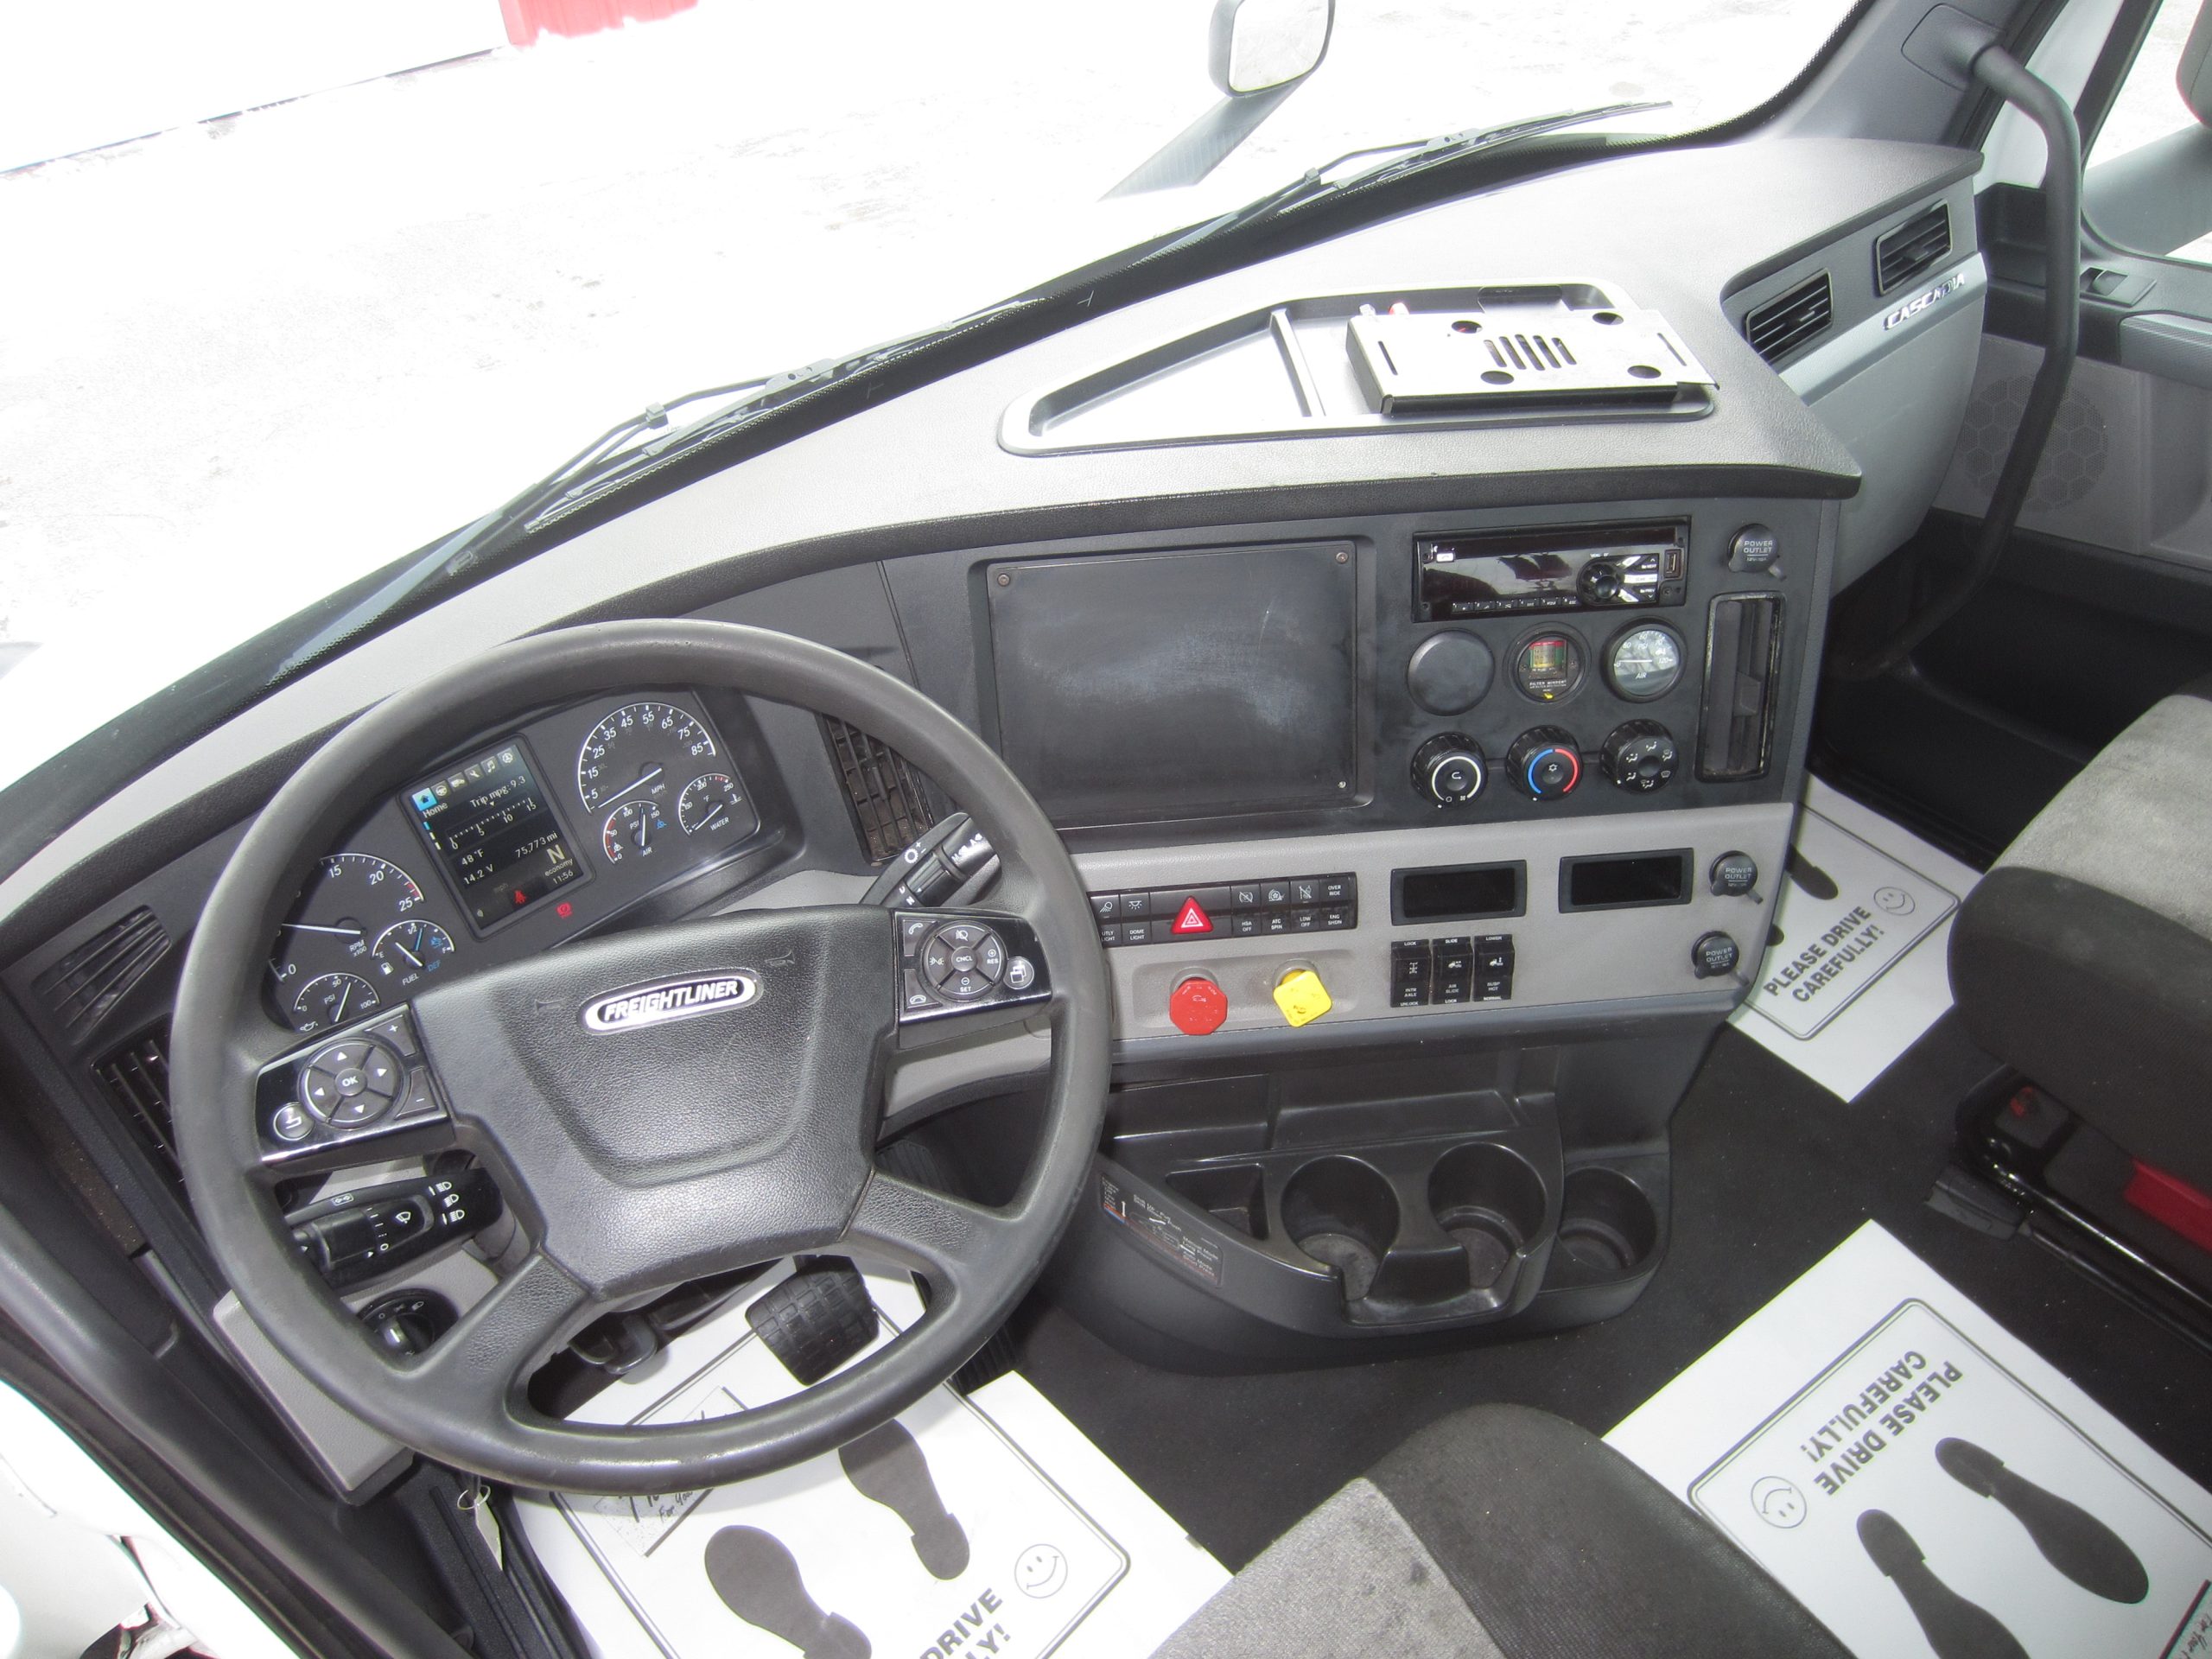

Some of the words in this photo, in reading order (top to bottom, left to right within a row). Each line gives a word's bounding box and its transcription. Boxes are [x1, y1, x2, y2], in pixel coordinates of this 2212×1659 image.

[1884, 272, 1965, 330] CASCADIA
[620, 715, 633, 728] 45
[643, 713, 655, 725] 55
[661, 717, 674, 729] 65
[604, 728, 617, 741] 35
[677, 728, 690, 740] 75
[593, 747, 605, 759] 25
[691, 744, 703, 755] 85
[588, 768, 599, 779] 15
[470, 795, 489, 808] Trip
[489, 785, 512, 801] mpg:
[510, 775, 526, 788] 9.3
[651, 784, 665, 794] MPH
[723, 782, 734, 791] 250
[592, 791, 599, 799] 5
[422, 802, 448, 819] Home
[526, 803, 537, 812] 15
[623, 809, 632, 818] 100
[503, 814, 513, 823] 10
[651, 810, 660, 819] 150
[629, 821, 639, 830] PSI
[710, 817, 730, 831] WATER
[546, 830, 558, 843] mi
[546, 844, 565, 864] N
[642, 847, 653, 857] AIR
[329, 865, 342, 878] 15
[544, 859, 573, 876] economy
[369, 871, 385, 886] 20
[463, 869, 485, 886] 14.2
[486, 864, 494, 873] V
[552, 870, 574, 885] 11:56
[398, 898, 413, 912] 25
[349, 939, 365, 952] RPM
[1706, 947, 1732, 957] POWER
[1763, 944, 1827, 997] PLEASE
[1821, 906, 1872, 947] DRIVE
[1706, 952, 1732, 963] OUTLET
[1792, 924, 1885, 1002] CAREFULLY!
[289, 963, 296, 976] 0
[428, 960, 442, 972] DEF
[402, 973, 420, 986] FUEL
[324, 994, 336, 1004] PSI
[359, 999, 372, 1009] 100
[604, 981, 738, 1021] FREIGHTLINER
[341, 1076, 359, 1087] OK
[1878, 1360, 1963, 1437] PLEASE
[1800, 1351, 1927, 1463] CAREFULLY!
[1814, 1429, 1887, 1496] DRIVE
